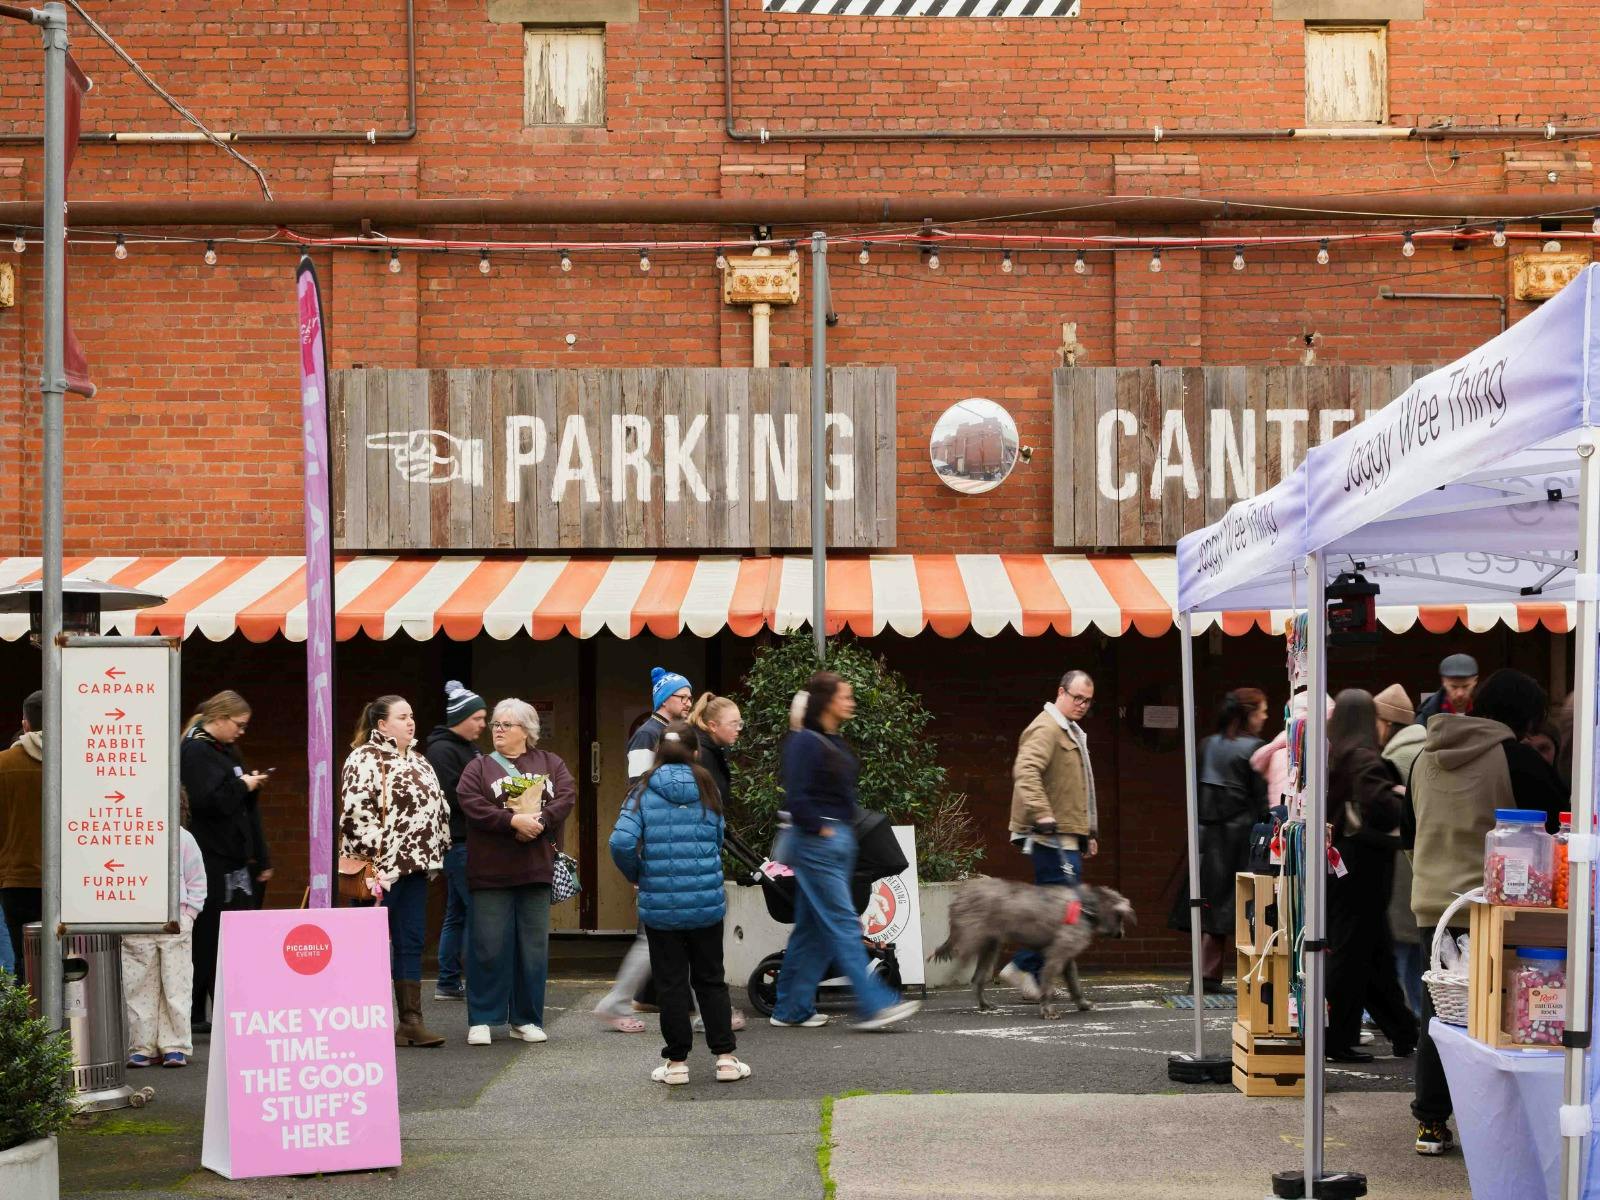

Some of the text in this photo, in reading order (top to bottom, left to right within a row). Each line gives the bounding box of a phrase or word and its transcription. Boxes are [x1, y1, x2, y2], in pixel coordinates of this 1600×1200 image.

[1344, 356, 1507, 495] Jaggy Wee Thing
[506, 413, 854, 502] PARKING
[1223, 512, 1246, 556] Wee
[1247, 501, 1279, 545] Thing
[78, 684, 155, 694] CARPARK
[90, 724, 143, 735] WHITE
[88, 738, 146, 749] RABBIT
[85, 752, 148, 763] BARREL
[96, 766, 137, 777] HALL
[89, 807, 143, 818] LITTLE
[68, 821, 165, 832] CREATURES
[78, 835, 155, 846] CANTEEN
[83, 876, 148, 887] FURPHY
[96, 890, 136, 901] HALL
[884, 876, 906, 904] REWING
[286, 944, 329, 952] PICCADILLY
[230, 1006, 387, 1035] TAKE YOUR
[266, 1037, 356, 1062] TIME...
[240, 1062, 384, 1094] THE GOOD
[261, 1092, 367, 1122] STUFF'S
[282, 1123, 350, 1150] HERE
